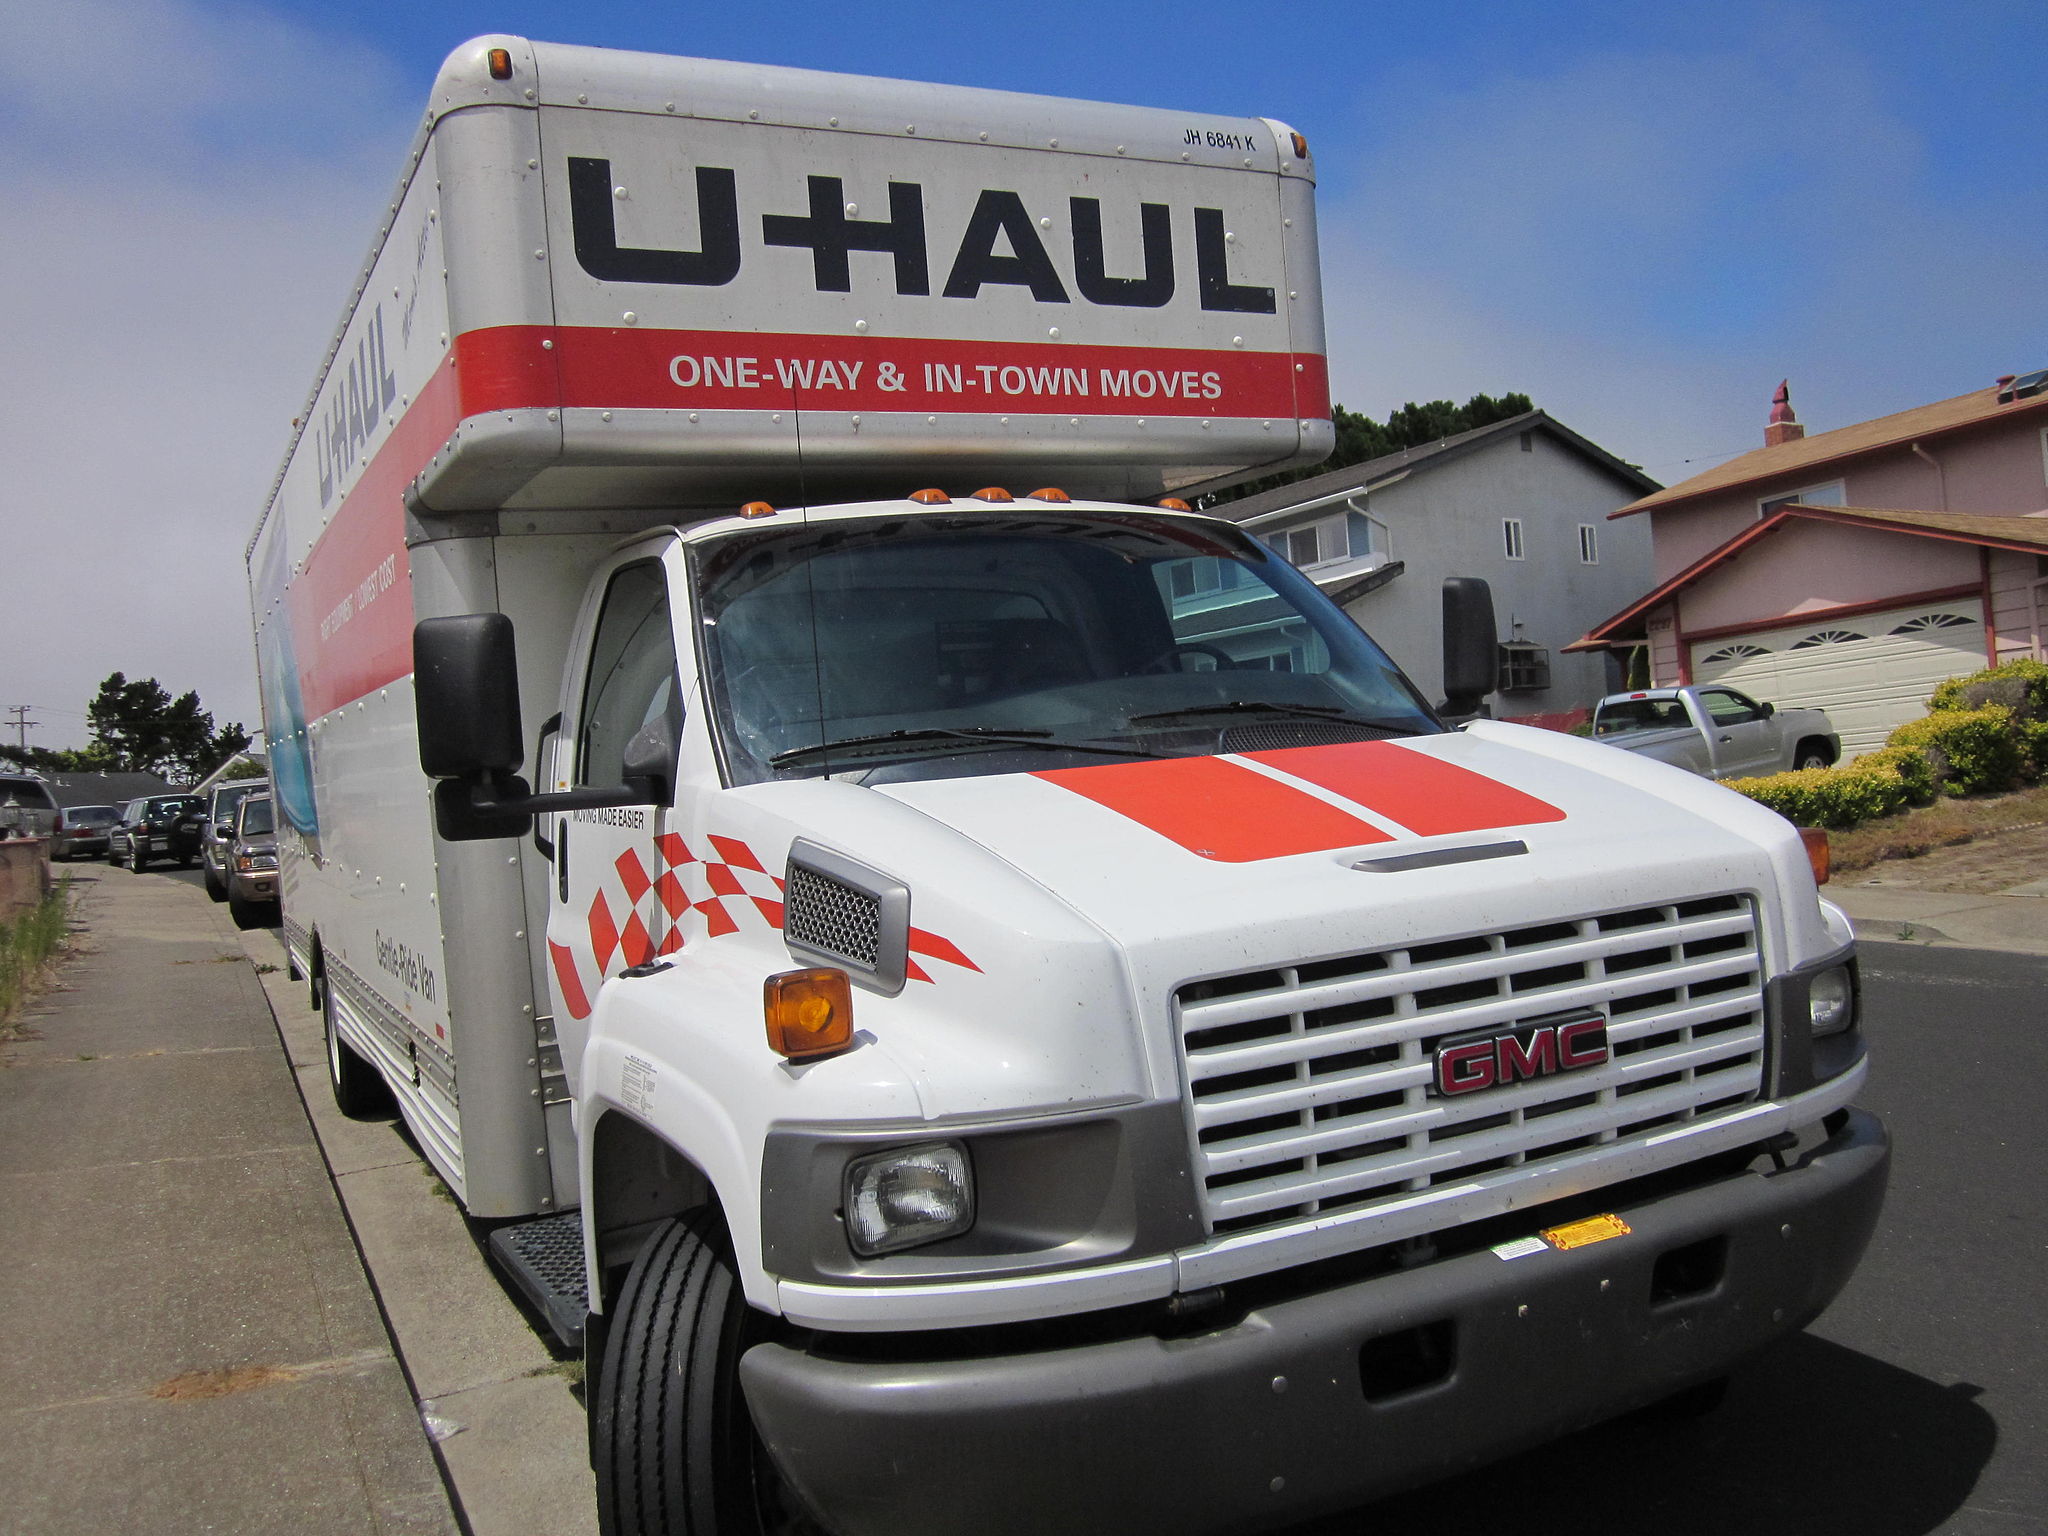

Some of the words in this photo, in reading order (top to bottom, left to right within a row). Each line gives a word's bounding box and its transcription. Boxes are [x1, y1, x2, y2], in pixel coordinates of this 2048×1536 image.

[1183, 129, 1202, 145] JH
[1206, 131, 1242, 150] 6841
[1244, 135, 1257, 152] K
[669, 355, 864, 391] ONE-WAY
[876, 361, 907, 392] &
[924, 363, 1090, 396] IN-TOWN
[1101, 369, 1222, 399] MOVES
[597, 808, 617, 826] MADE
[618, 809, 645, 830] EASIER
[417, 952, 436, 1005] Van
[1438, 1016, 1609, 1096] GMC
